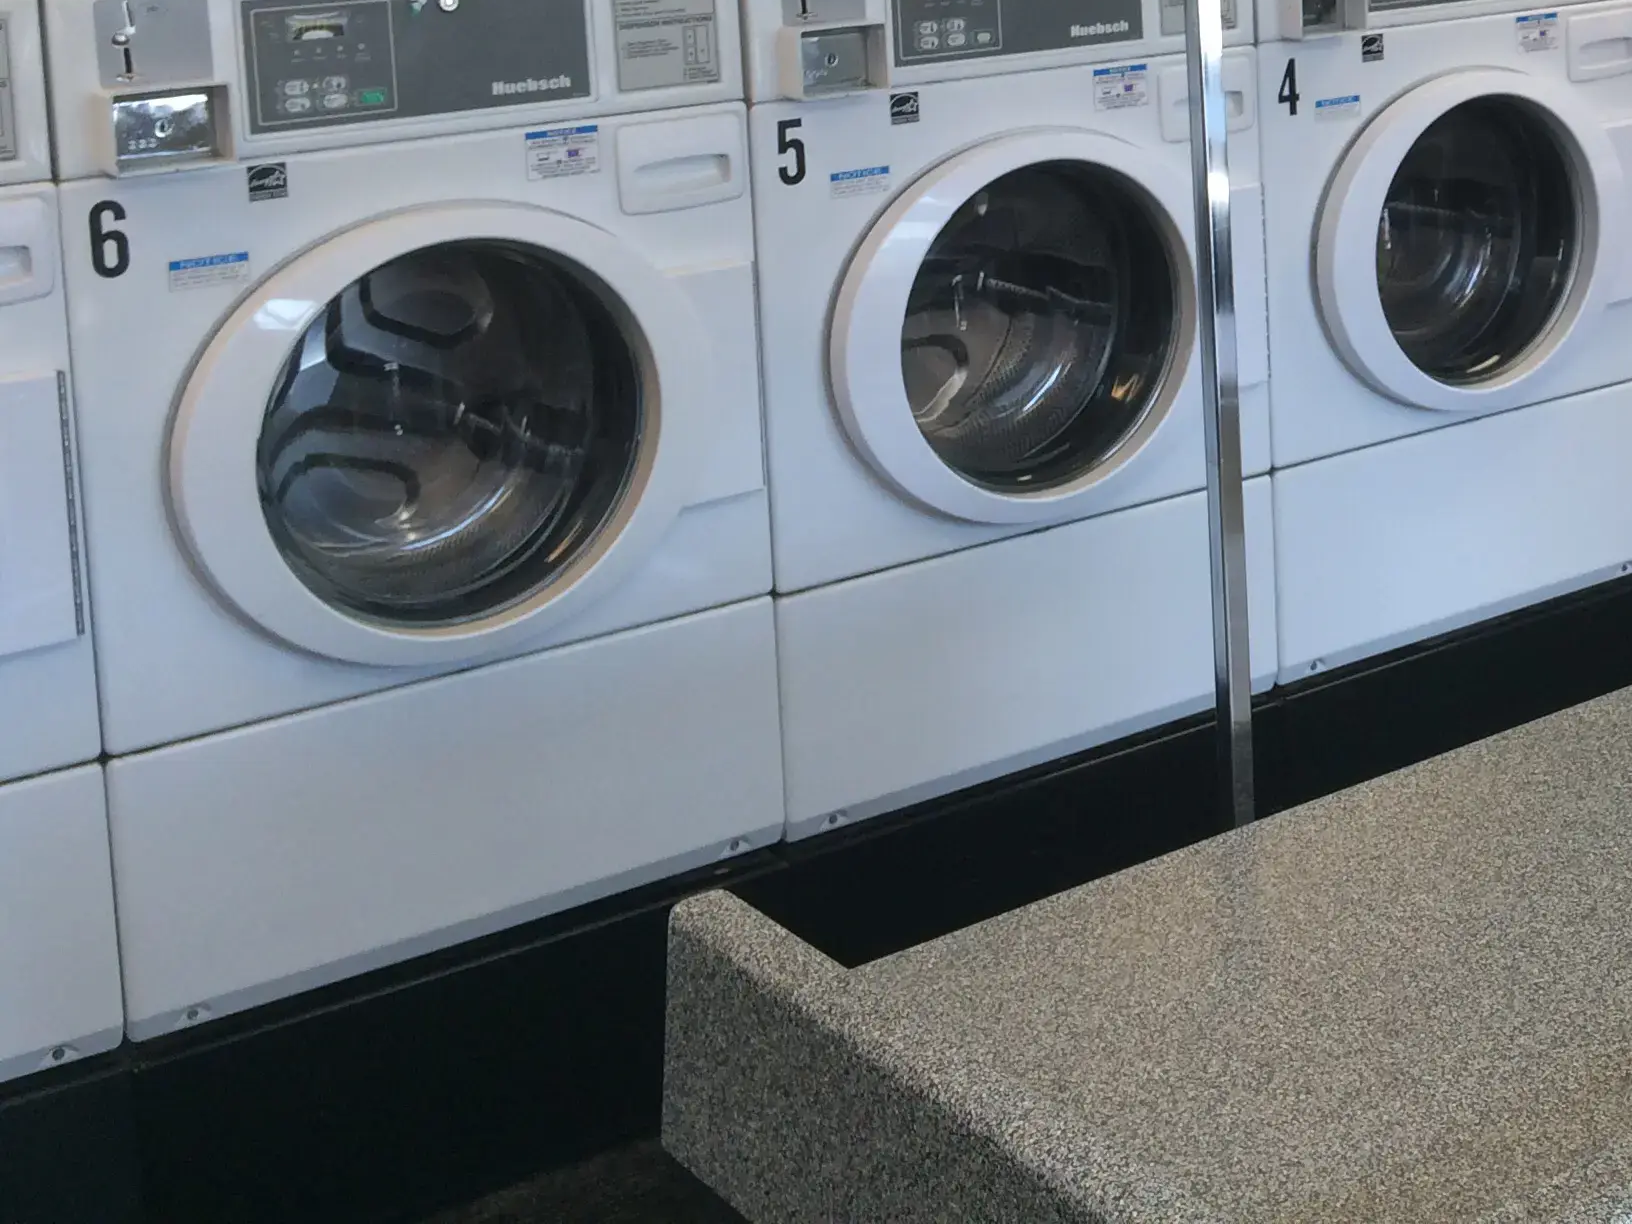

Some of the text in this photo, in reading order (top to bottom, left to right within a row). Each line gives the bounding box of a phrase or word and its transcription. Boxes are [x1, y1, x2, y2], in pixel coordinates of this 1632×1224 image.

[1070, 20, 1129, 39] Huebsch
[492, 74, 572, 96] Huebsch
[1278, 58, 1300, 116] 4
[777, 118, 806, 186] 5
[89, 200, 130, 278] 6
